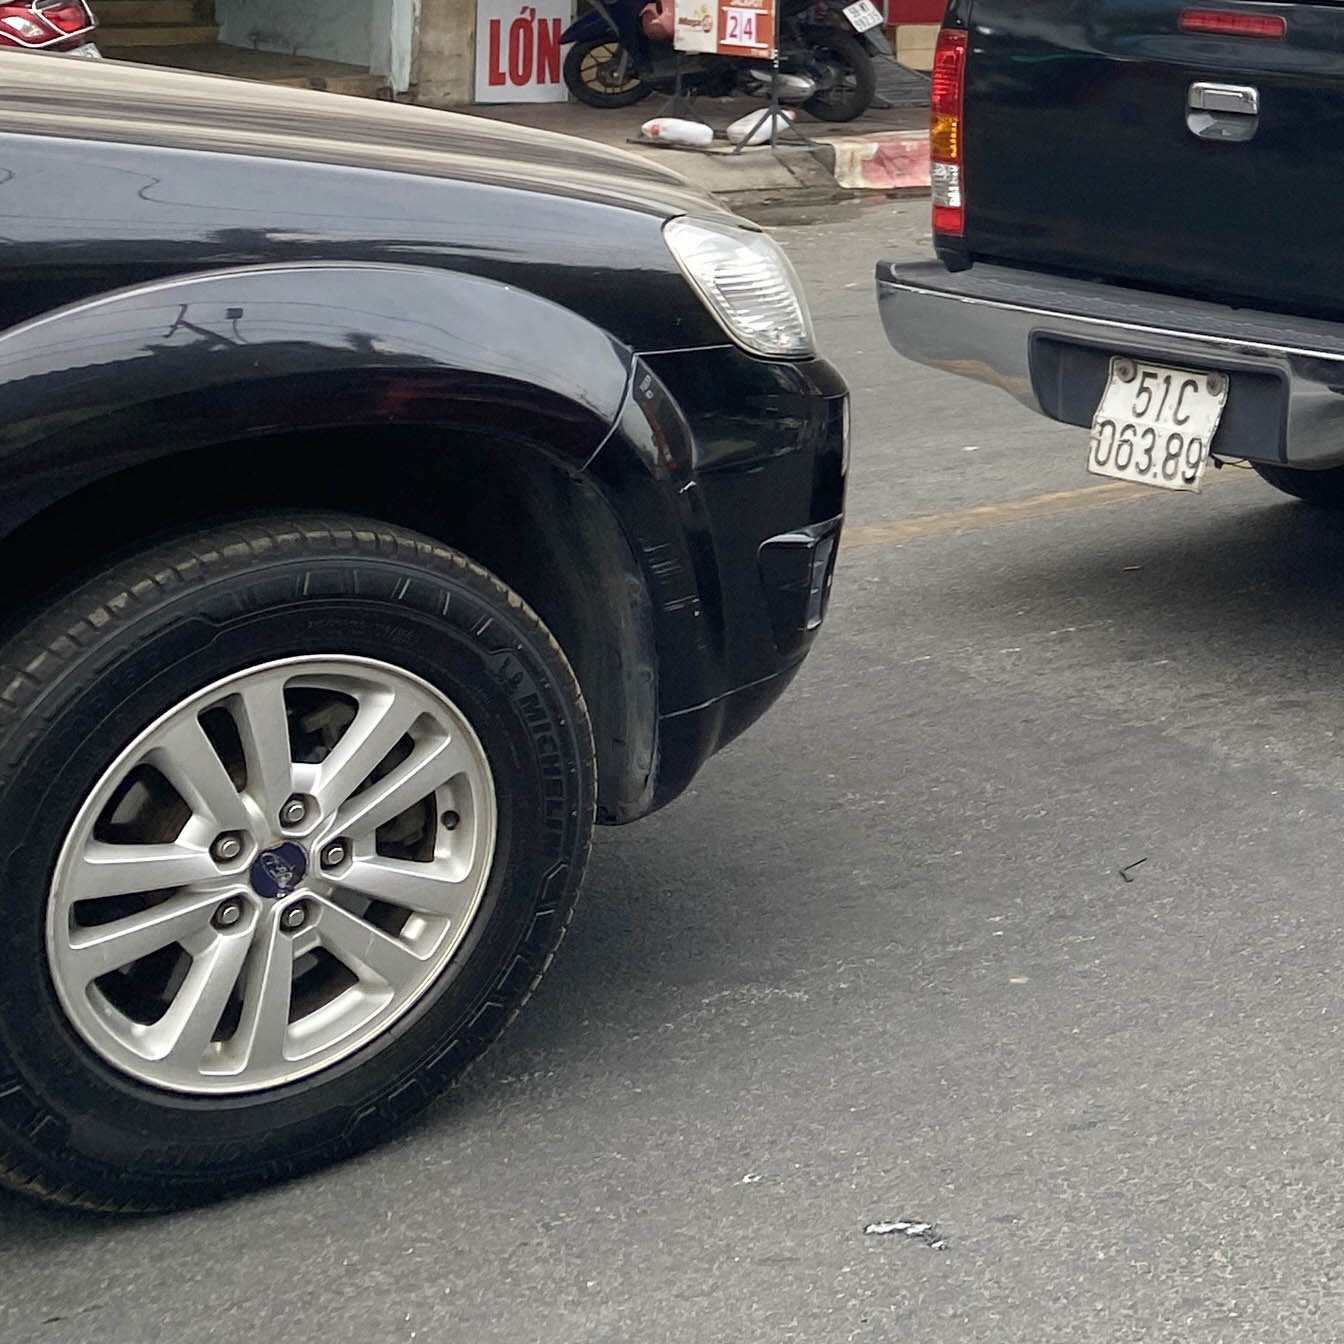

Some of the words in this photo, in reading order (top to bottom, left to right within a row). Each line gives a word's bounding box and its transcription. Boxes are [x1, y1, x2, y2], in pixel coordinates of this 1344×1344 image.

[488, 6, 562, 86] LỚN
[728, 15, 753, 40] 24
[1132, 371, 1199, 426] 51C
[1094, 419, 1203, 485] 063.89
